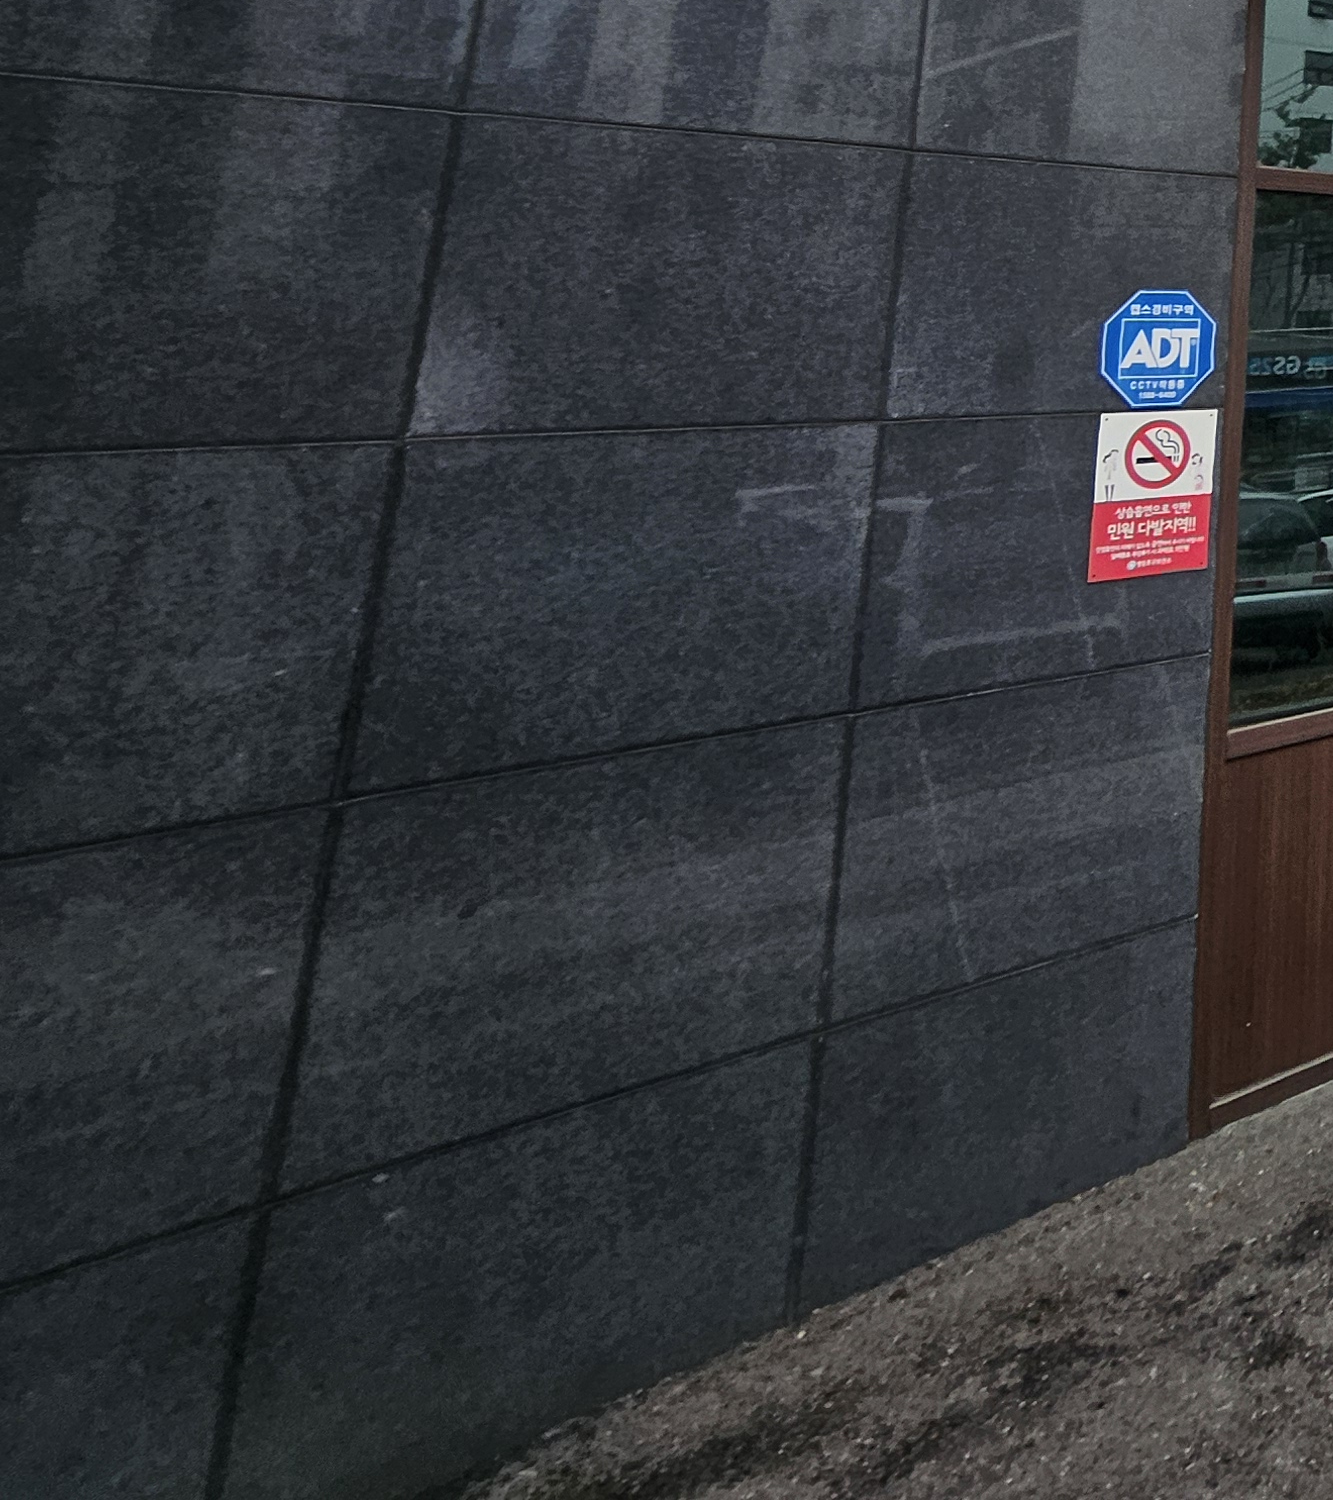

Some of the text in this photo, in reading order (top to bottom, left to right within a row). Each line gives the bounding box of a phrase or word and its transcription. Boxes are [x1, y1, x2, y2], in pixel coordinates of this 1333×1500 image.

[1120, 328, 1200, 369] ADT
[1115, 501, 1192, 520] 상습흡연으로 인한
[1107, 516, 1196, 540] 민원 다발지역!!
